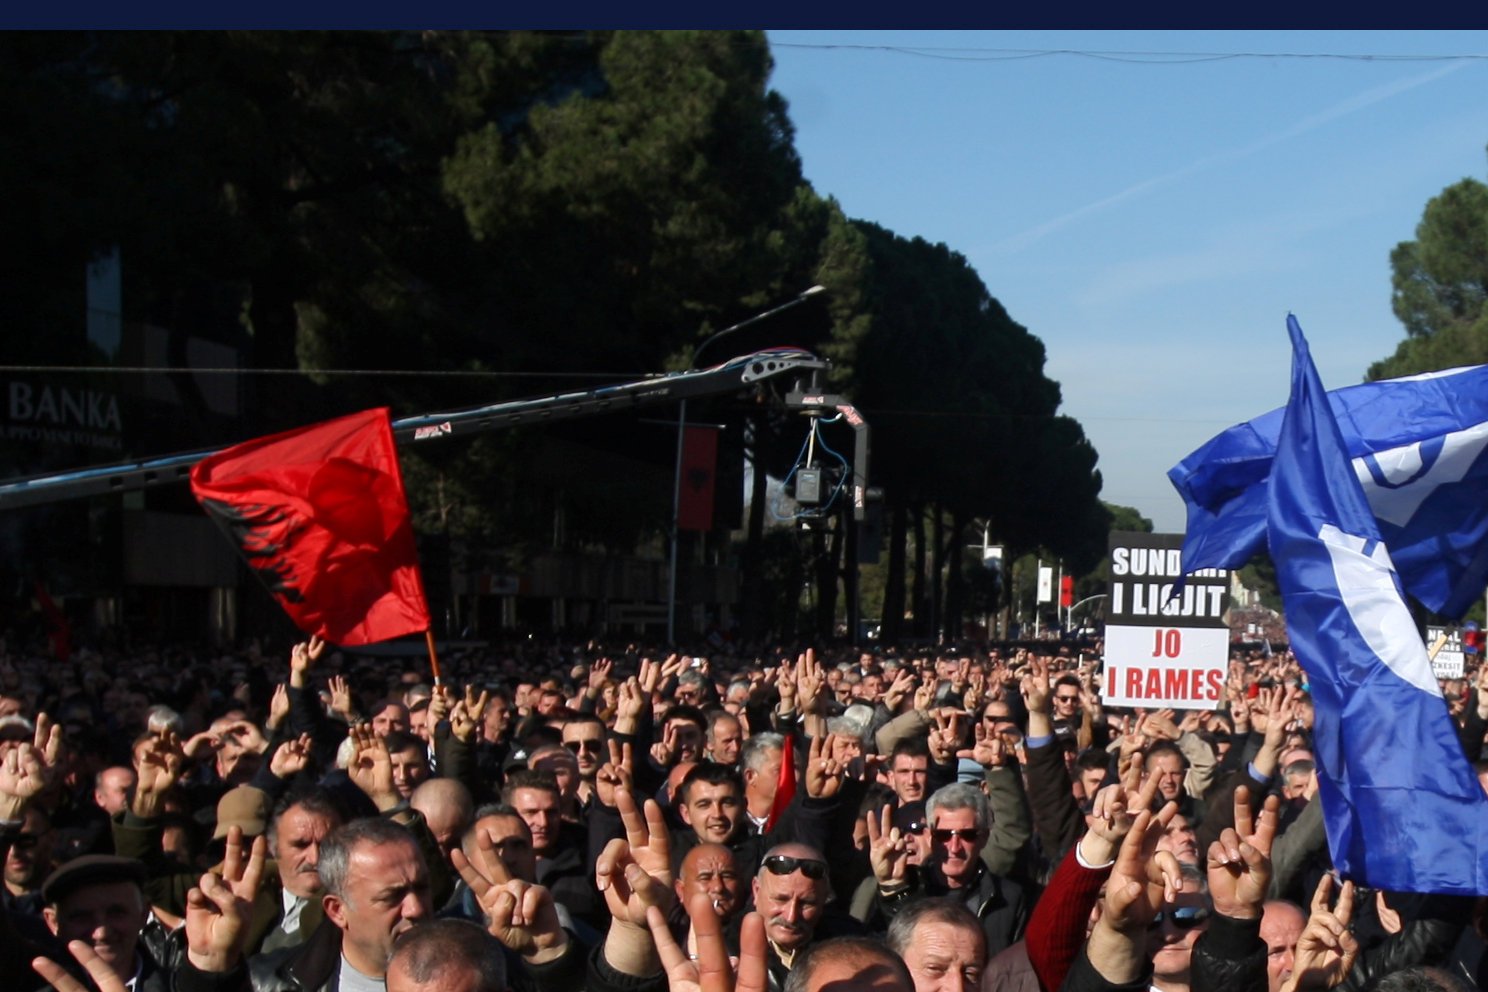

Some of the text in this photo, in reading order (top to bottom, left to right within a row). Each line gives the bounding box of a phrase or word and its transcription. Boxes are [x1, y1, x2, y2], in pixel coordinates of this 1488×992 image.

[8, 380, 123, 433] BANKA
[1112, 547, 1227, 578] SUND
[1112, 582, 1227, 617] I LIGJIT
[1152, 629, 1182, 658] JO
[1107, 667, 1224, 701] I RAMES
